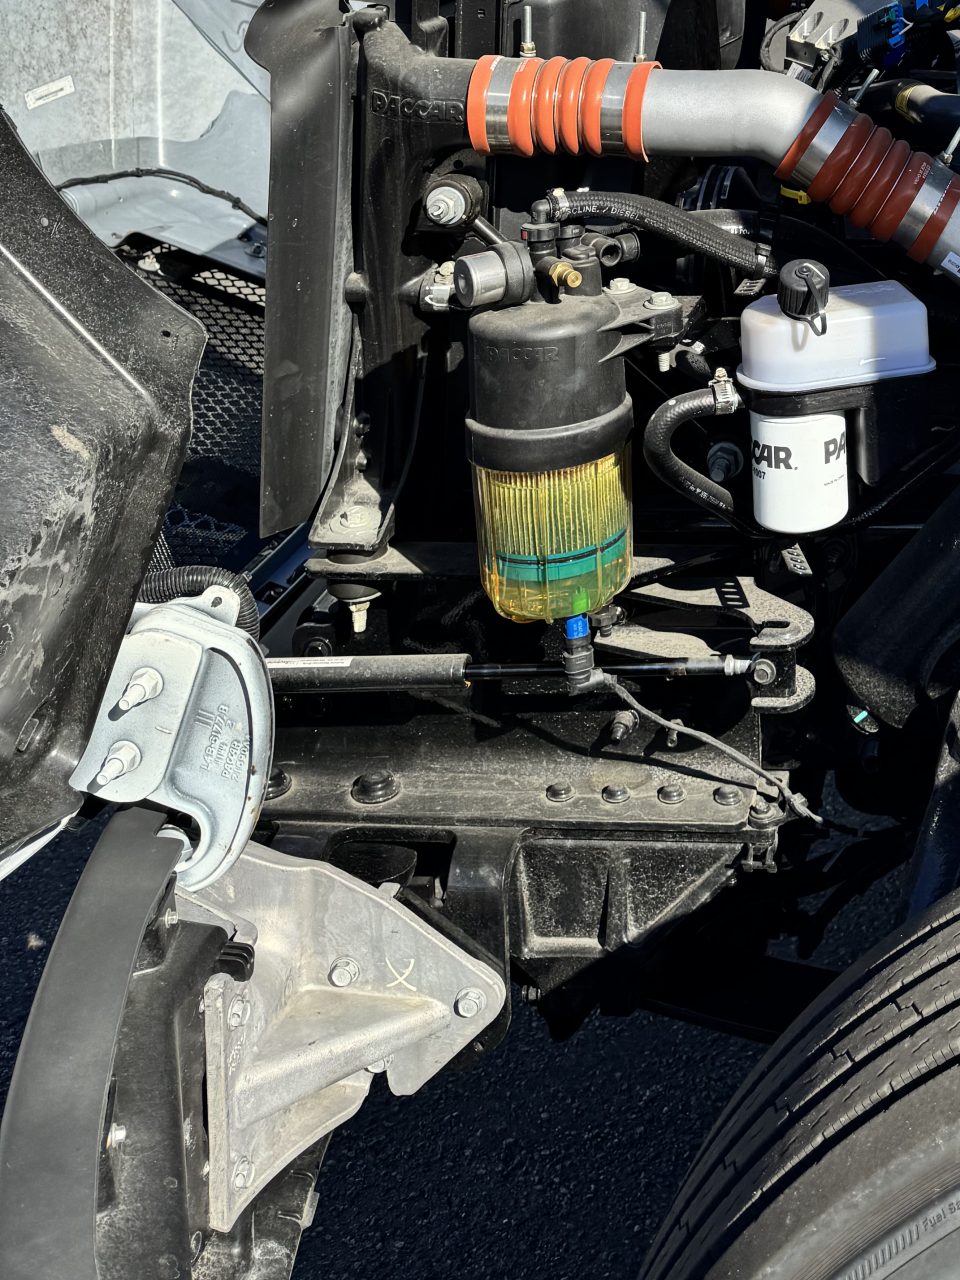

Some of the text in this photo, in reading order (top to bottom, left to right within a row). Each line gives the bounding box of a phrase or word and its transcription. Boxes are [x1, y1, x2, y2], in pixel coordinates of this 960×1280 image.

[369, 88, 466, 124] PACCAR
[824, 431, 846, 465] PA
[922, 1208, 947, 1232] Fuel
